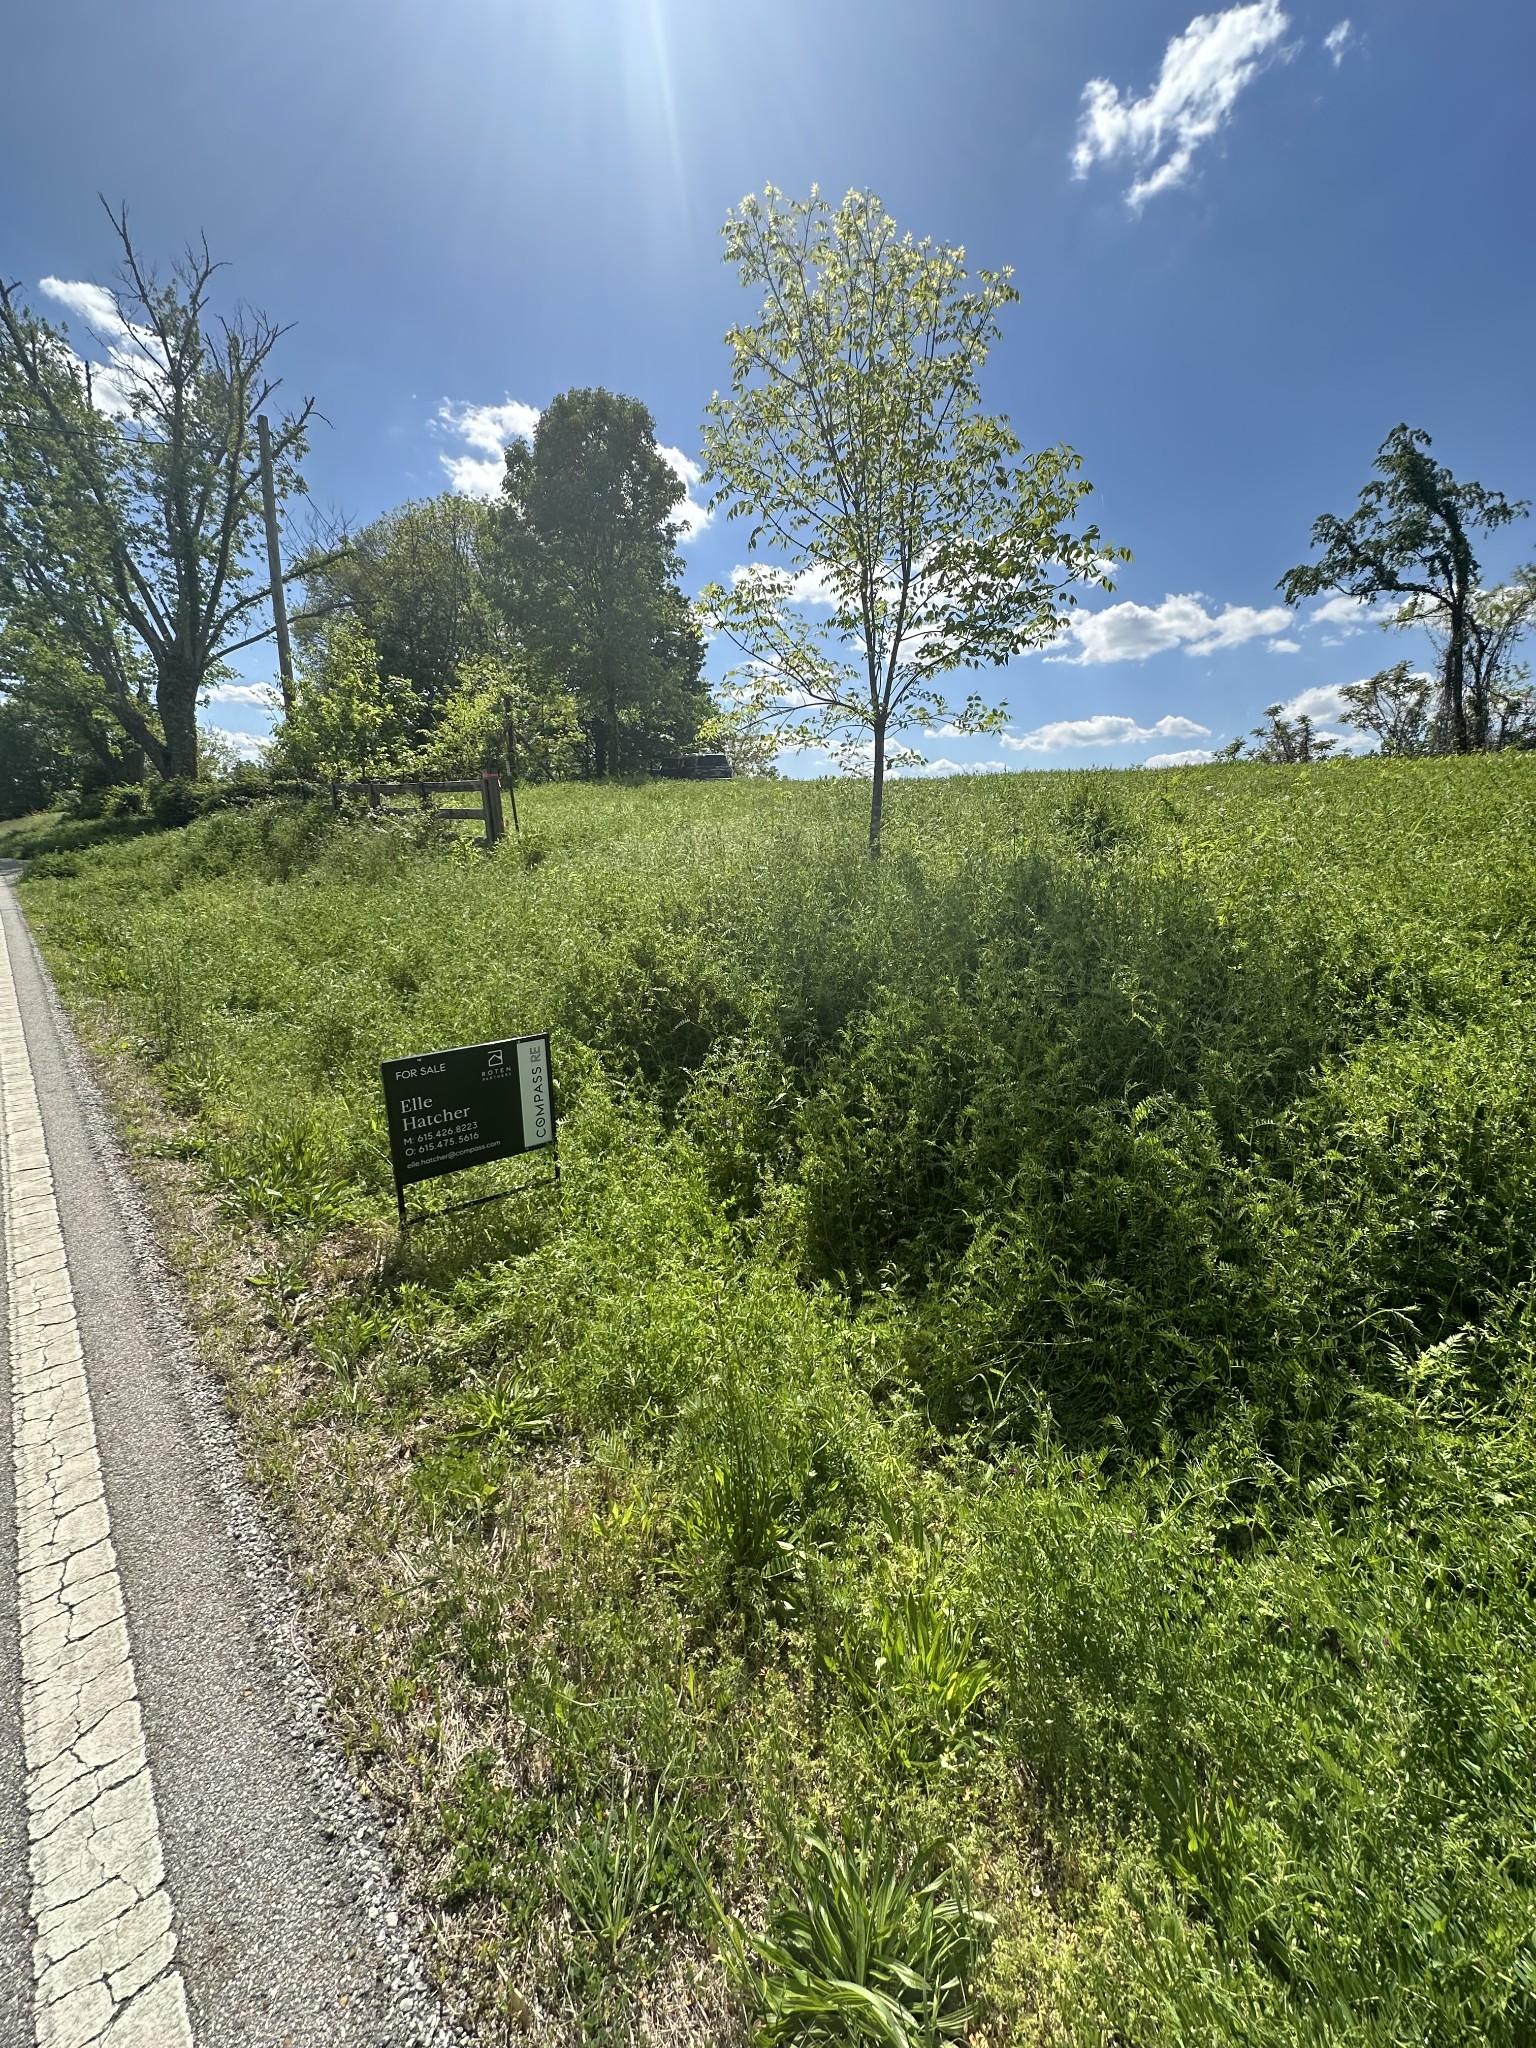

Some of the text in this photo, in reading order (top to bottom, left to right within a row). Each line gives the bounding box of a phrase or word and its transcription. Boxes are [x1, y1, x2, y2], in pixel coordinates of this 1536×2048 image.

[396, 1063, 446, 1080] FOR SALE
[482, 1067, 511, 1077] ROTEN
[530, 1046, 546, 1137] COMPASS RE
[401, 1096, 433, 1114] Elle
[402, 1106, 470, 1131] Hatcher
[403, 1121, 478, 1146] M: 615.426.8223
[405, 1132, 479, 1157] O: 615.475.5616
[406, 1141, 501, 1169] elle.hatcher@compass.com
